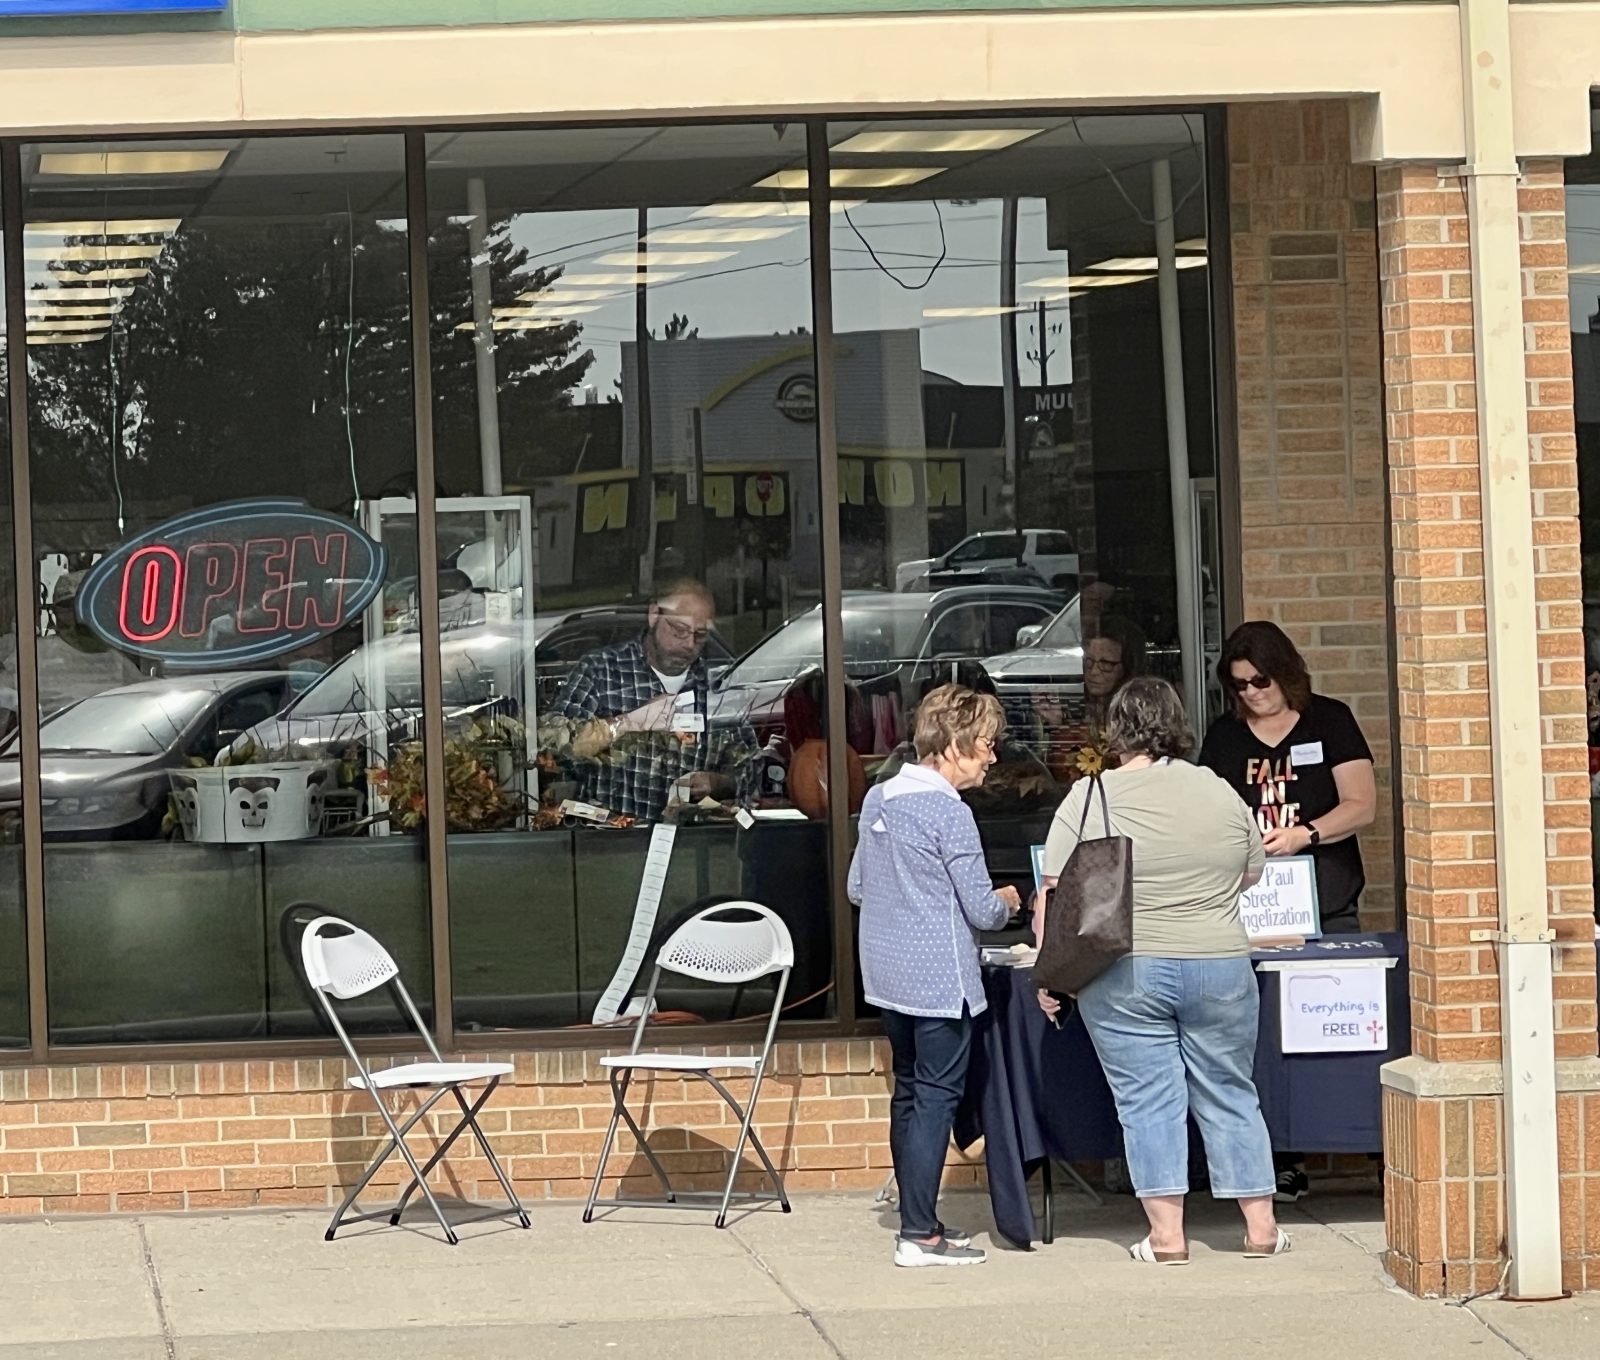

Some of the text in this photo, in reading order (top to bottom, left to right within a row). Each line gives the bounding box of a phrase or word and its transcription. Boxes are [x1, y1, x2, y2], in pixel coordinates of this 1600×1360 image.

[119, 533, 347, 641] OPEN
[1246, 754, 1299, 785] FALL
[1261, 781, 1286, 805] IN
[1248, 802, 1300, 835] OVE
[1265, 866, 1294, 887] Paul
[1242, 890, 1281, 909] Street
[1242, 906, 1311, 933] ngelization
[1301, 1000, 1380, 1016] Everything is
[1322, 1022, 1361, 1036] FREE!
